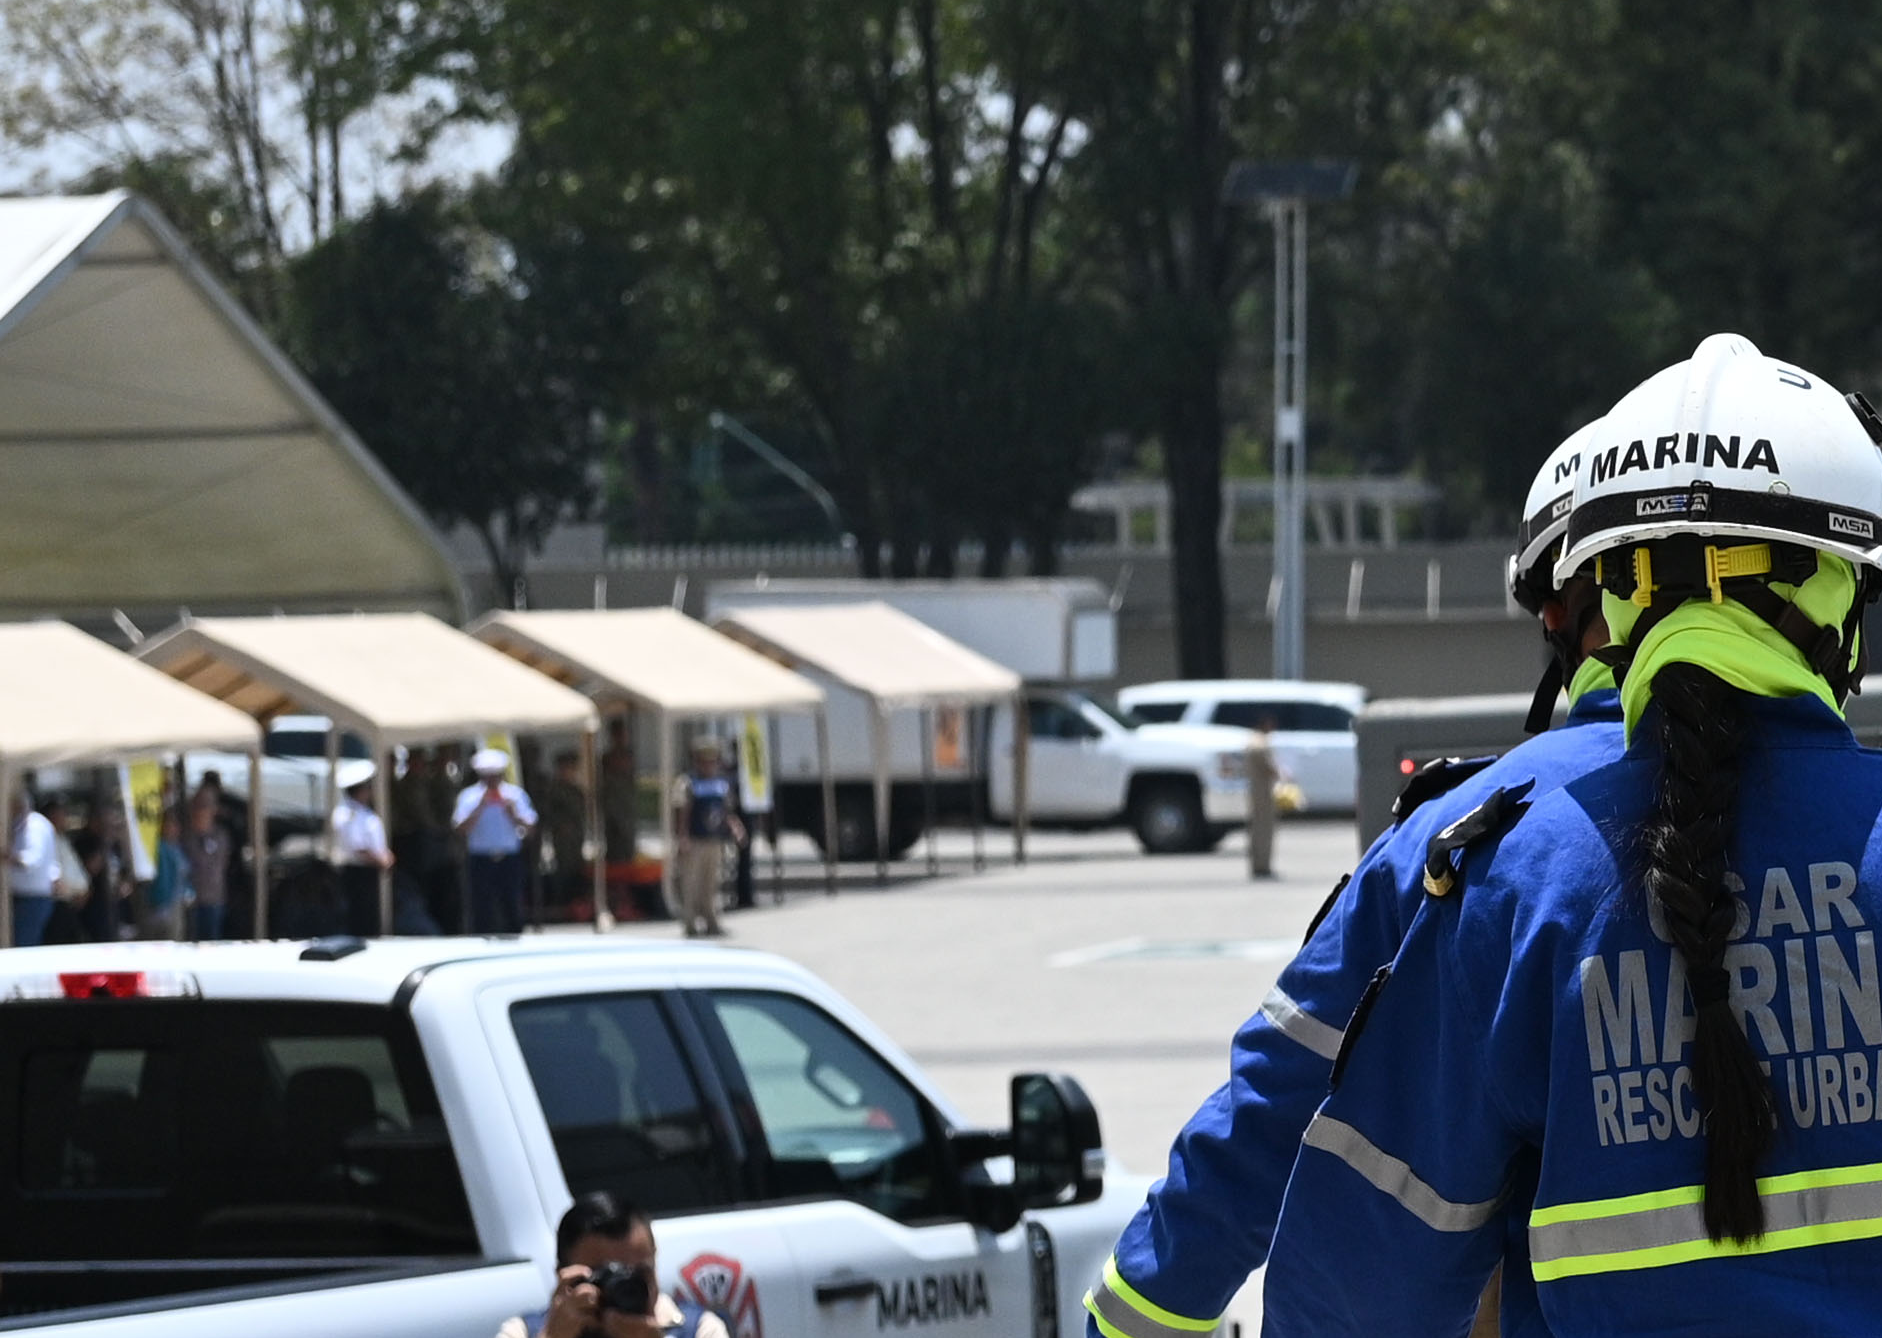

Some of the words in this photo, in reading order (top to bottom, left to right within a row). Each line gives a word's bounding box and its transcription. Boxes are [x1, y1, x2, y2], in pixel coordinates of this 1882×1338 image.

[1589, 432, 1780, 488] MARINA
[1832, 517, 1872, 537] MSA
[1592, 1061, 1777, 1146] RESC
[875, 1270, 991, 1330] MARINA
